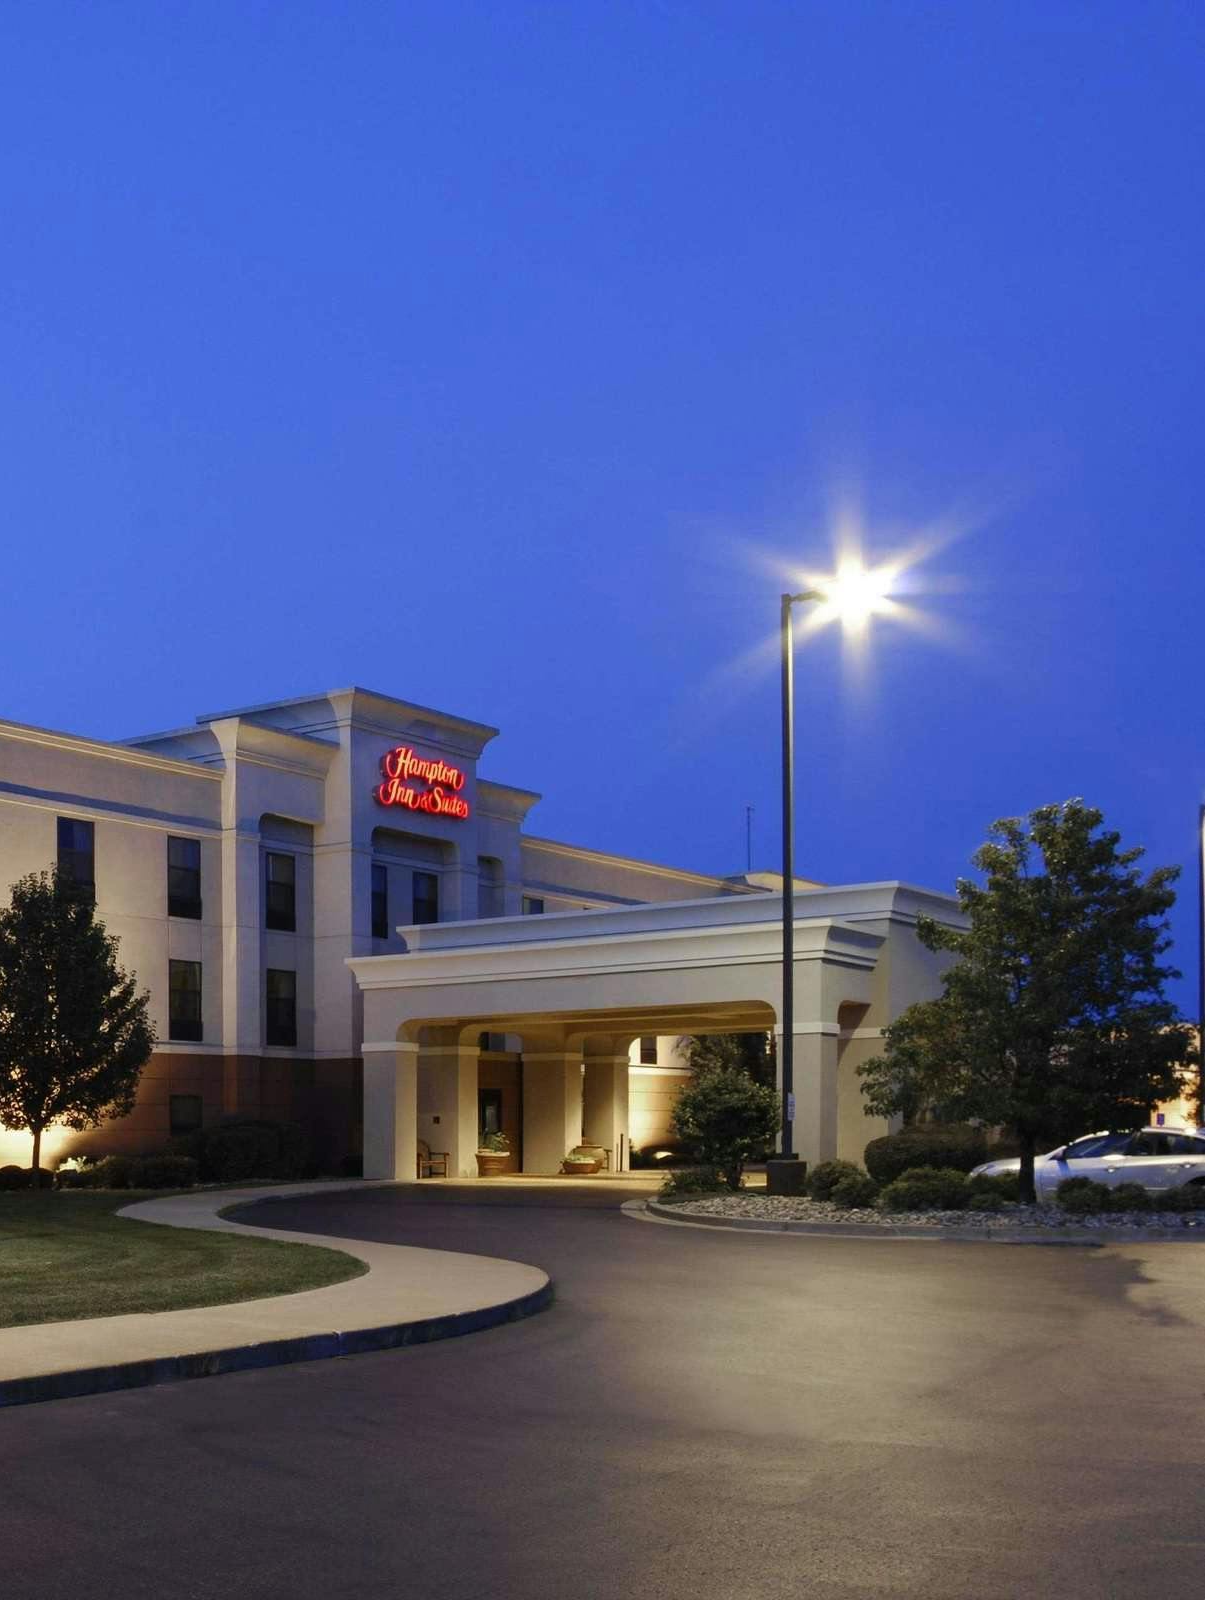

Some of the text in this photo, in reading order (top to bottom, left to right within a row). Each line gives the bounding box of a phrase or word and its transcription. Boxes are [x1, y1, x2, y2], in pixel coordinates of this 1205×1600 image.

[385, 746, 464, 790] Hampton
[379, 778, 420, 809] Inn
[428, 786, 468, 818] Suites
